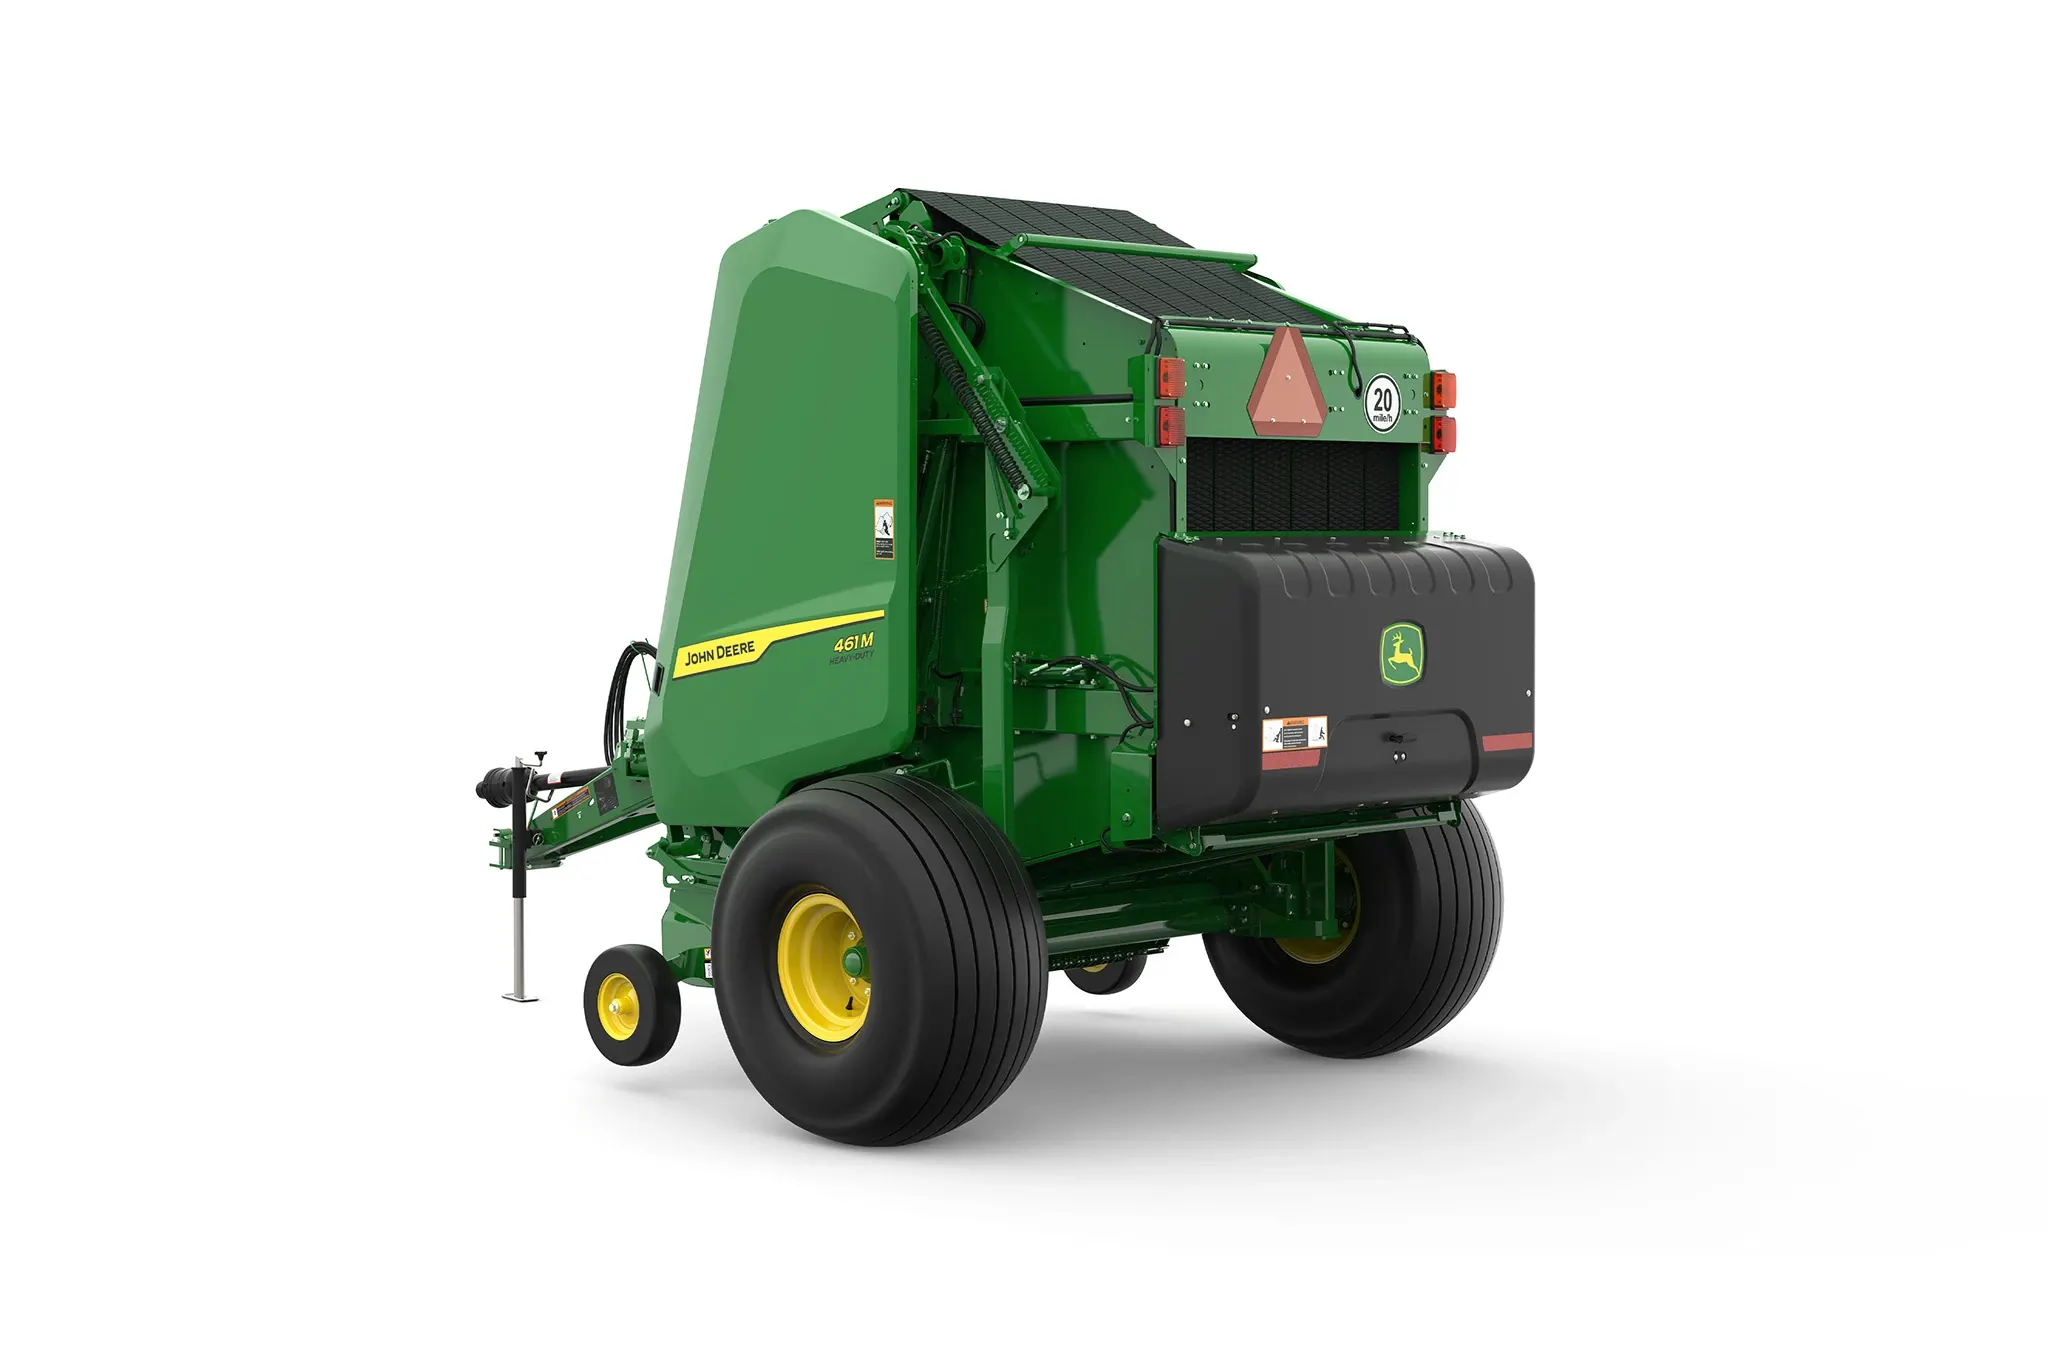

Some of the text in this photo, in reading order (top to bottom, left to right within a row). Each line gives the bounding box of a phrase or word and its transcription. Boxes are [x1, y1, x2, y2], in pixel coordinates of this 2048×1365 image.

[1374, 388, 1392, 411] 20
[685, 641, 755, 666] JOHN DEERE
[829, 650, 875, 665] HEAVY-DUTY
